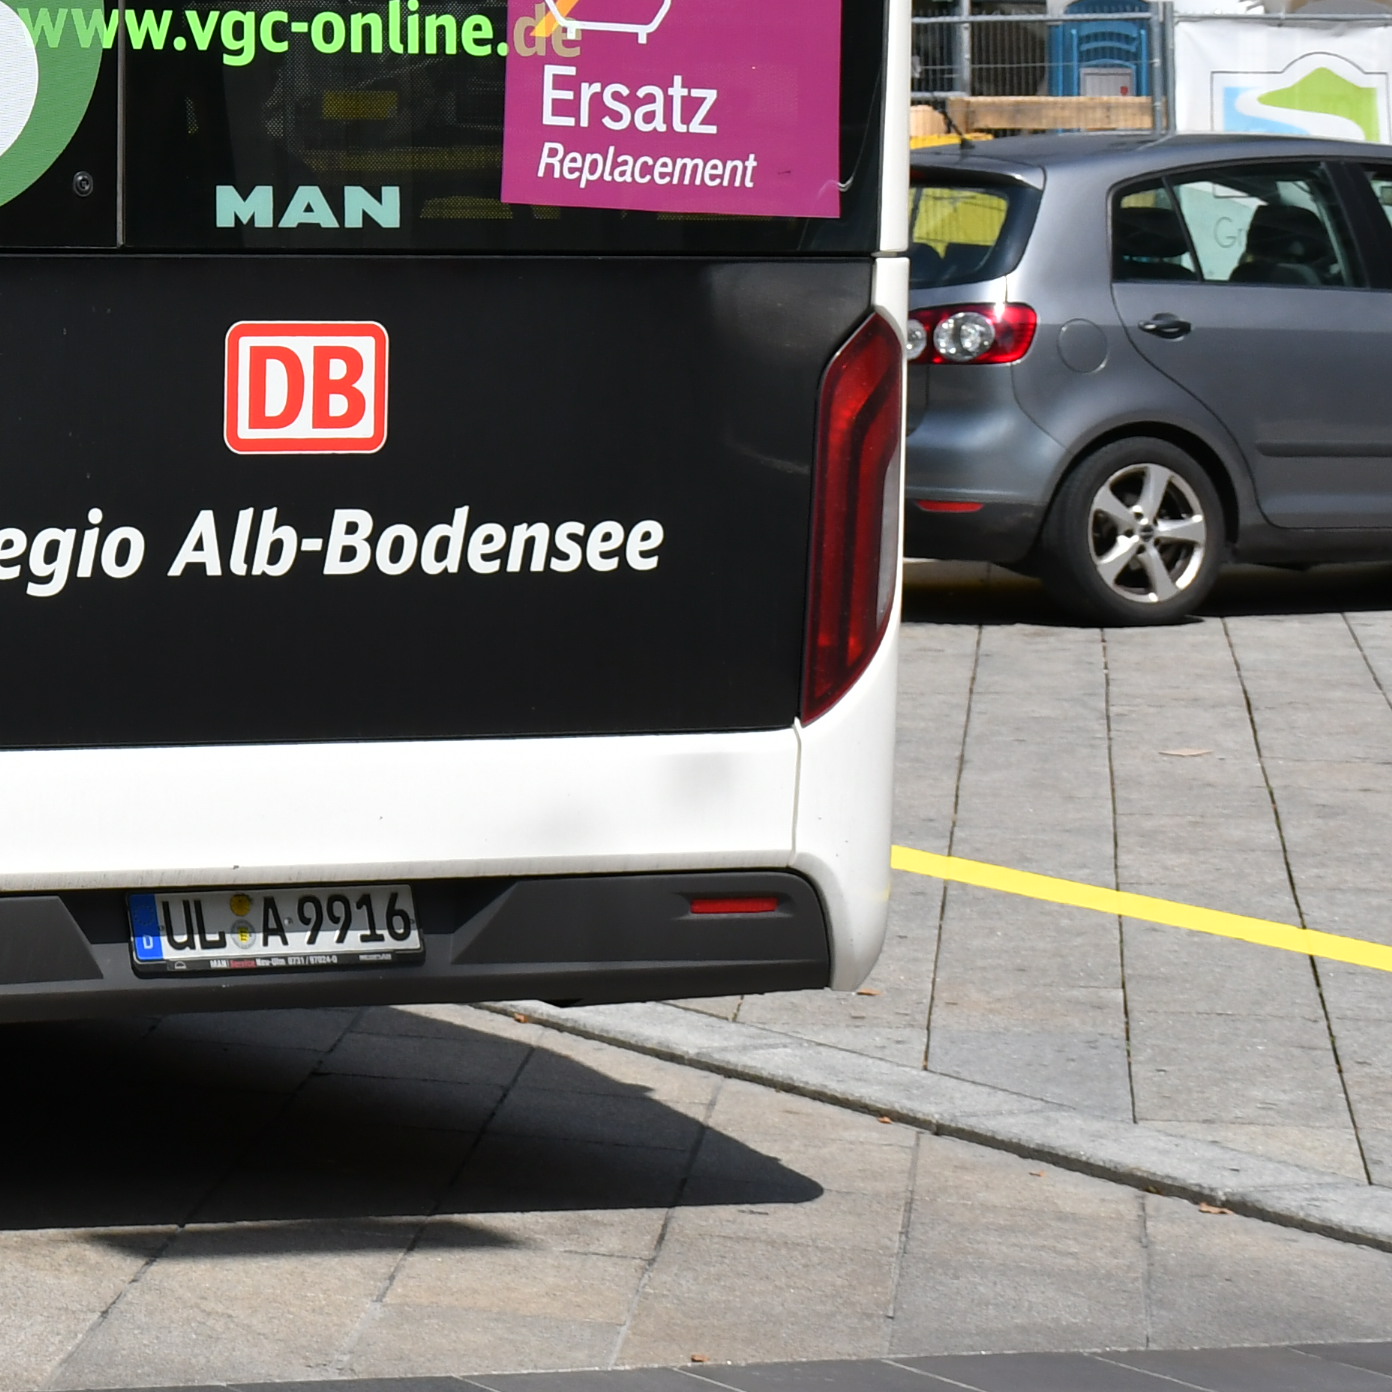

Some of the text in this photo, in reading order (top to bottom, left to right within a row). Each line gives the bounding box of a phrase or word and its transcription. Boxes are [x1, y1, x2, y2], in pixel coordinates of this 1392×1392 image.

[542, 64, 718, 134] Ersatz
[537, 141, 758, 189] Replacement
[216, 185, 400, 228] MAN
[248, 345, 366, 430] DB
[168, 505, 664, 577] Alb-Bodensee
[142, 936, 154, 949] D
[162, 899, 227, 950] UL
